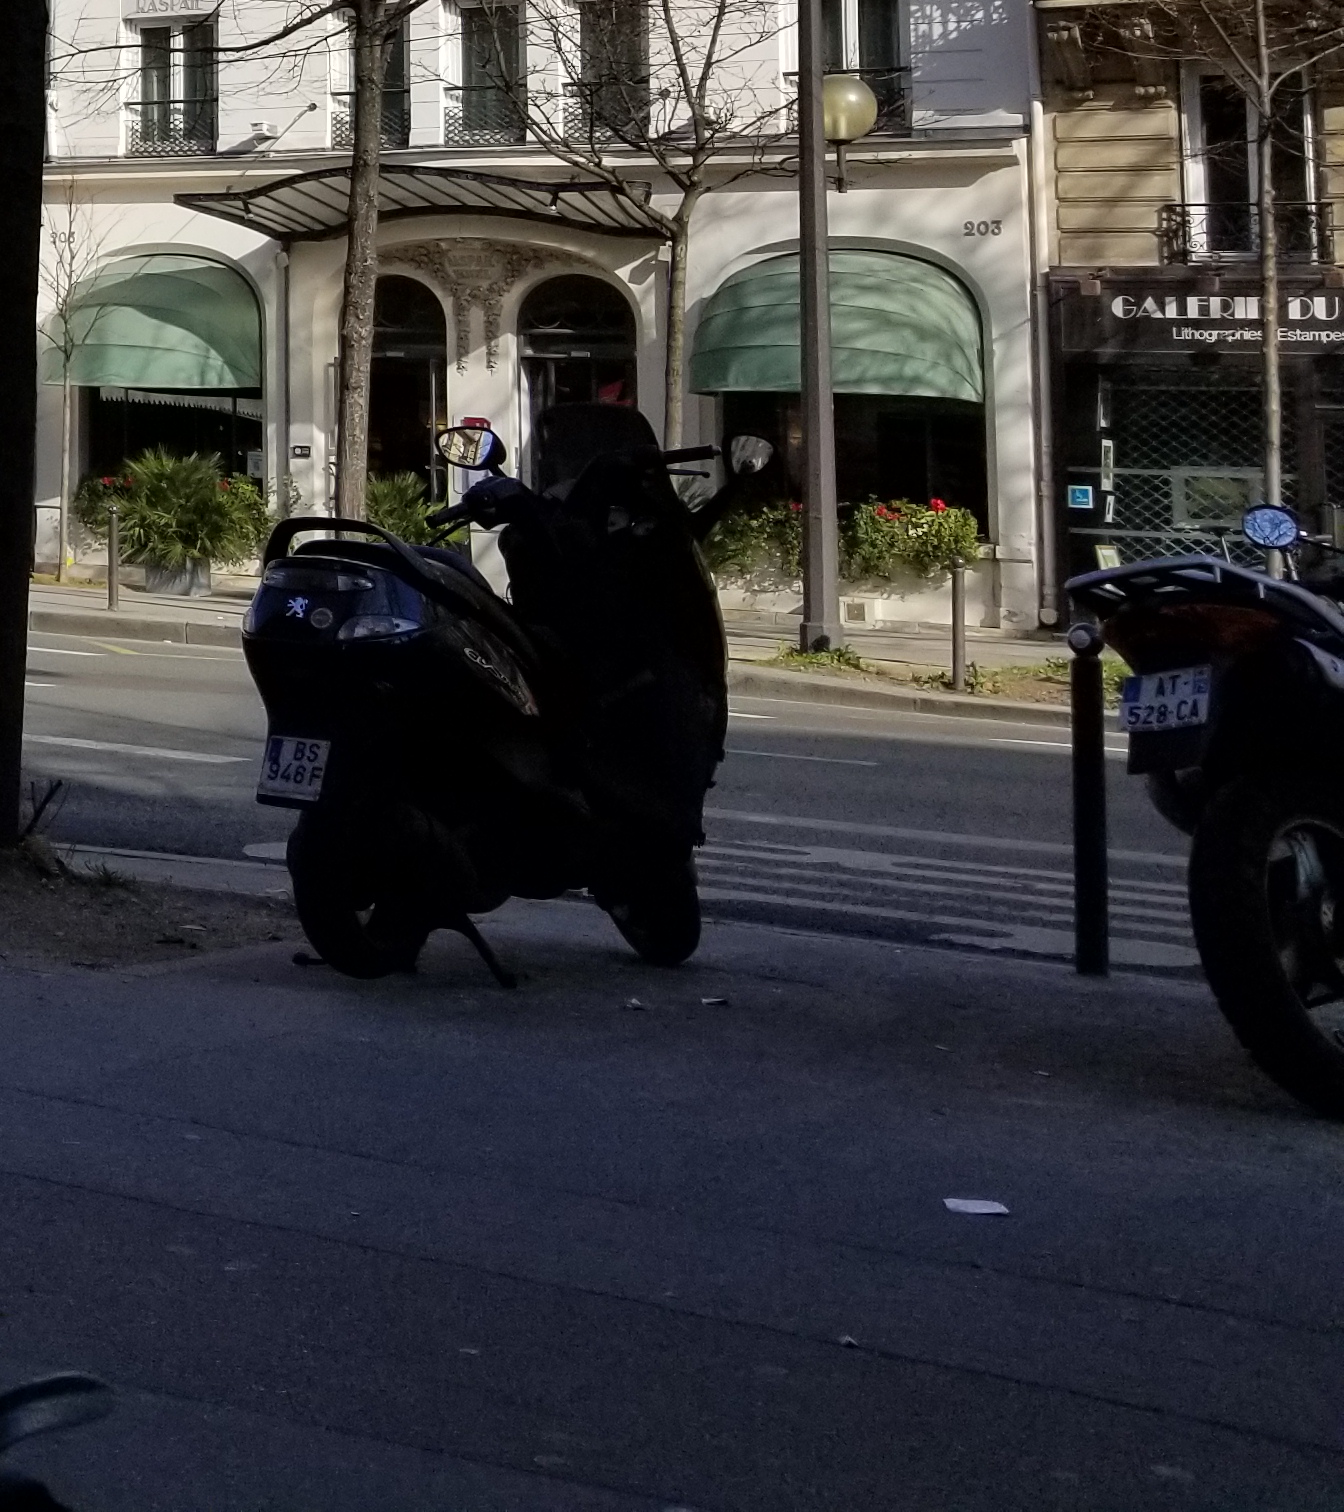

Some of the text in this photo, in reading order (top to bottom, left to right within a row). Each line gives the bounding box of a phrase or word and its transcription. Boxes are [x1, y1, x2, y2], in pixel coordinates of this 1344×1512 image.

[963, 219, 1003, 237] 203
[1288, 295, 1340, 321] DU
[294, 740, 321, 763] BS
